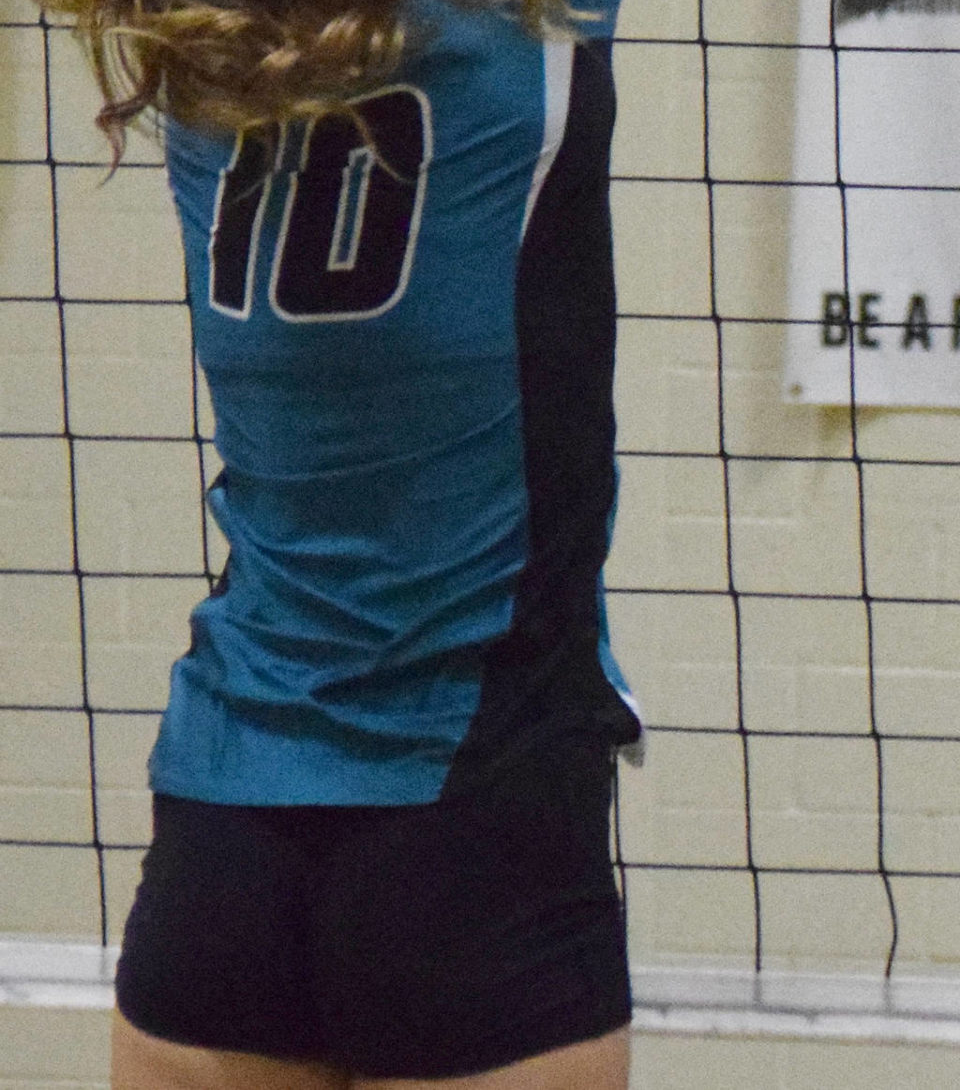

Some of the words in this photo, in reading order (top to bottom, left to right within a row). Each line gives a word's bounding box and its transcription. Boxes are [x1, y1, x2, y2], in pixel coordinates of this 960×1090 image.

[208, 83, 434, 323] 10
[820, 291, 882, 348] BE
[902, 292, 931, 351] A
